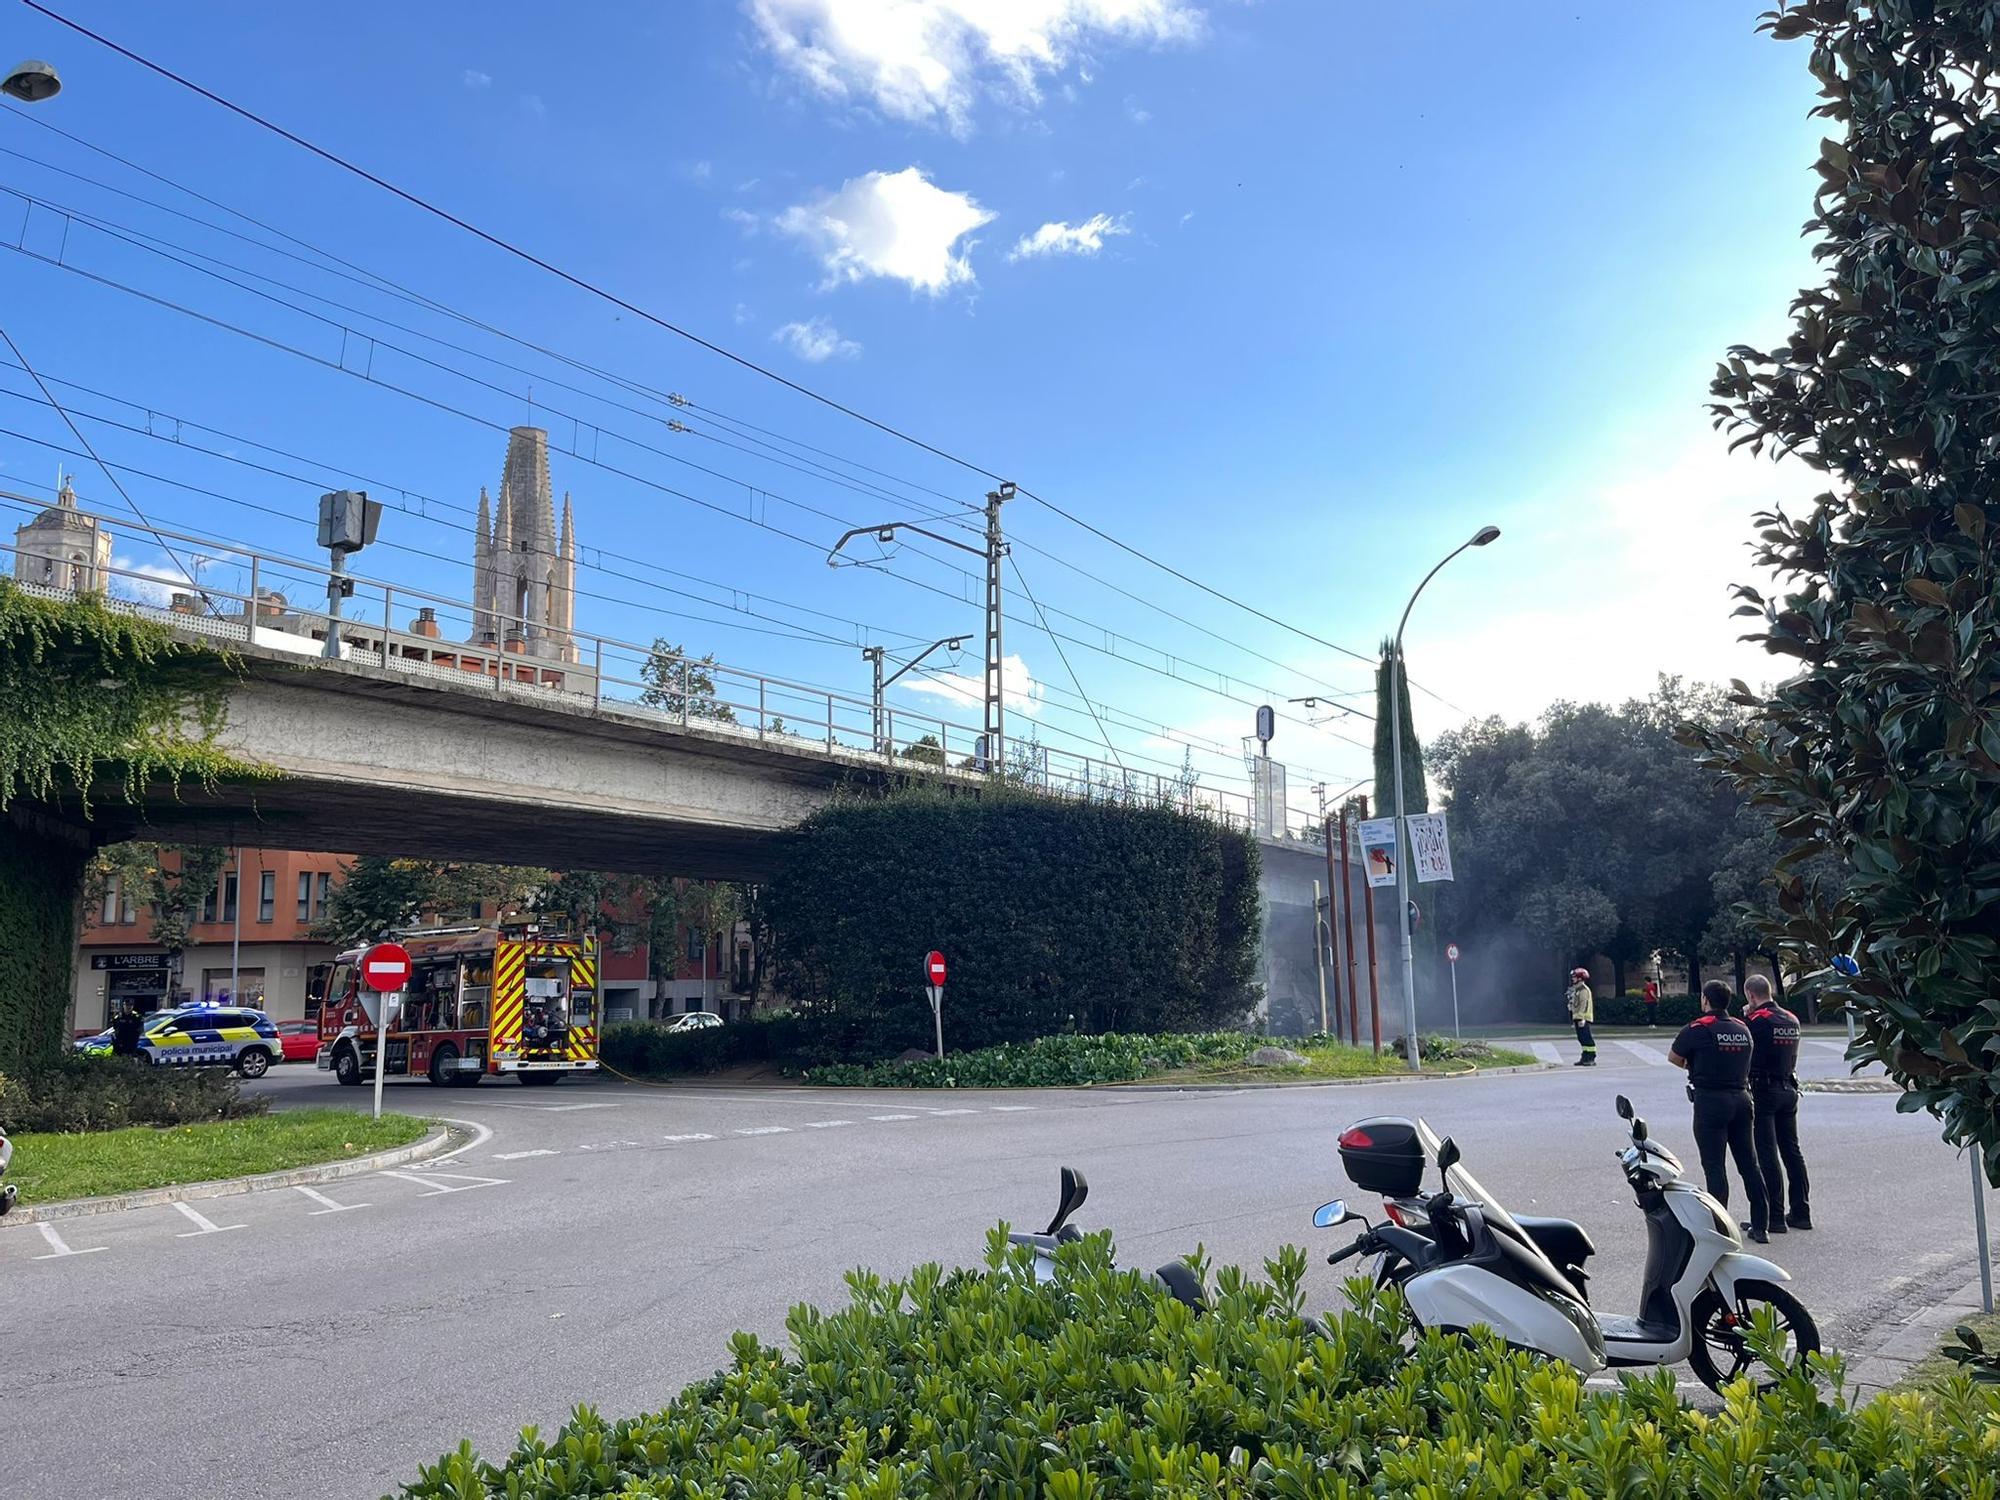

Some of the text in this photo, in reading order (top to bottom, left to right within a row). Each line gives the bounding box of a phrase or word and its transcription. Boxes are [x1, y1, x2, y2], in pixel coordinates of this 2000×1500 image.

[114, 955, 160, 964] L'ARBRE
[1717, 1033, 1748, 1042] POLICIA
[161, 1044, 233, 1056] policia municipal
